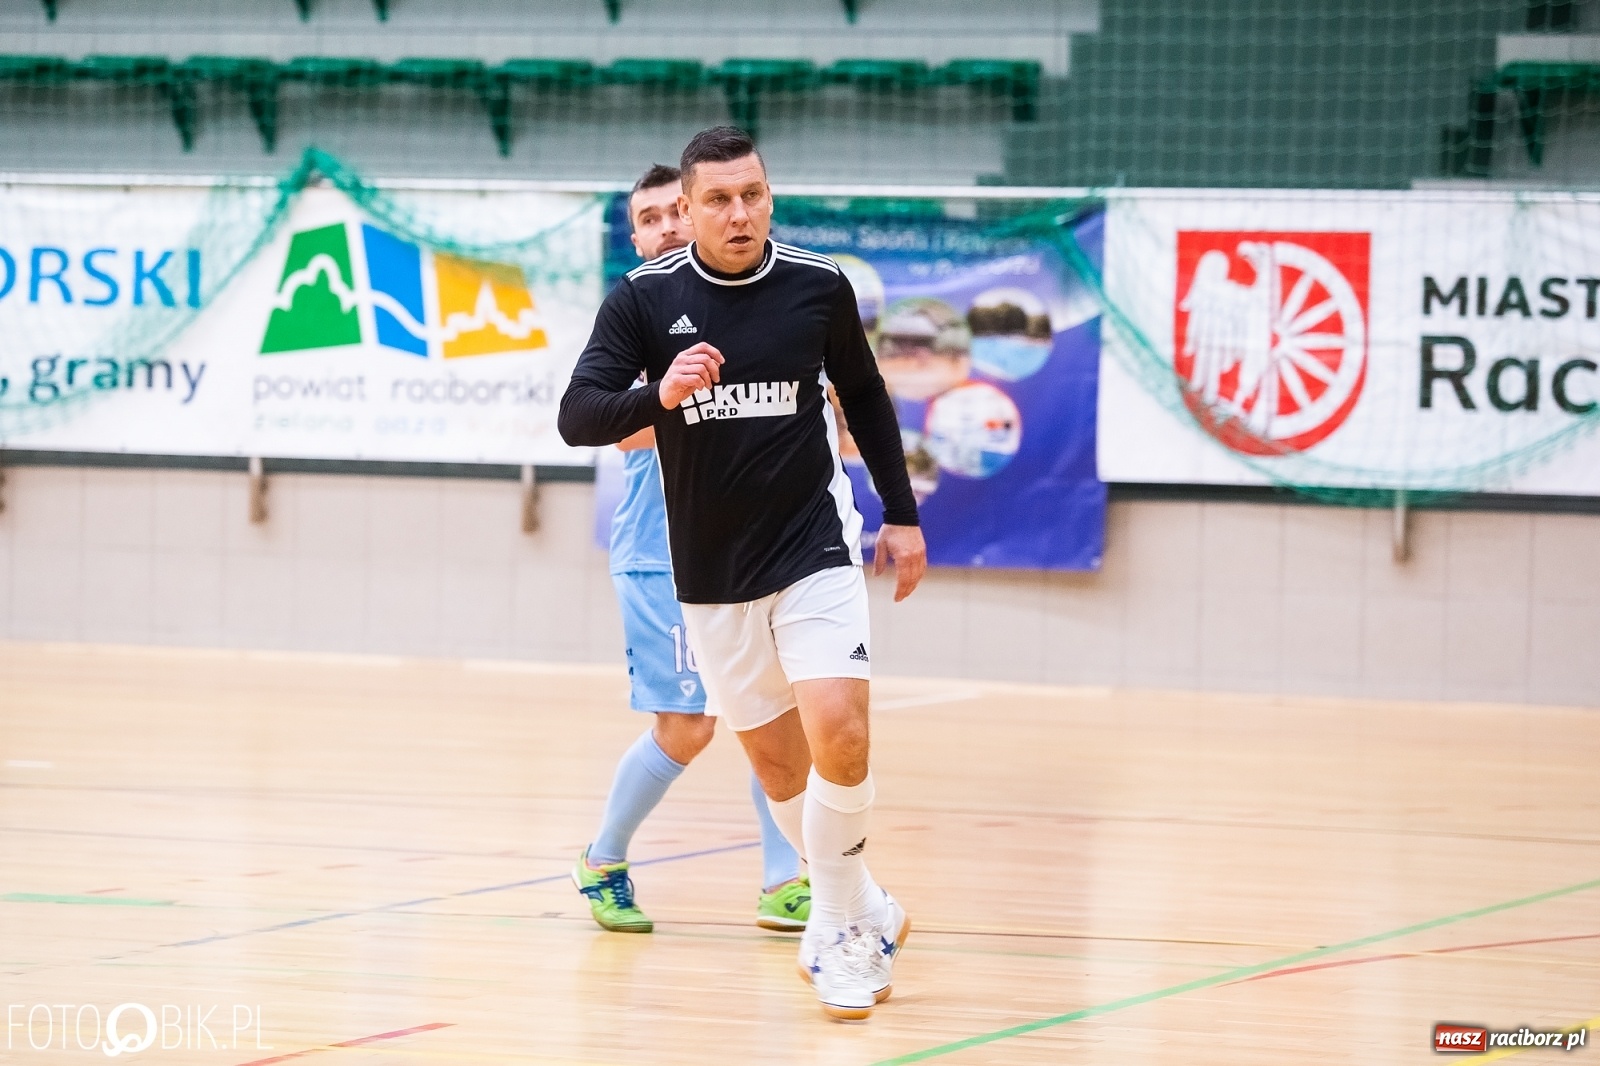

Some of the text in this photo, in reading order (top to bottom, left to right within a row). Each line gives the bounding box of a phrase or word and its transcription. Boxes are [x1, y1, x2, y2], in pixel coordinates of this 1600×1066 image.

[1422, 276, 1600, 318] MIAST
[669, 327, 698, 335] adidas
[29, 354, 206, 404] gramy
[252, 374, 366, 406] powiat
[1419, 335, 1599, 414] Rac
[714, 381, 800, 406] KUHN
[706, 408, 739, 418] PRD
